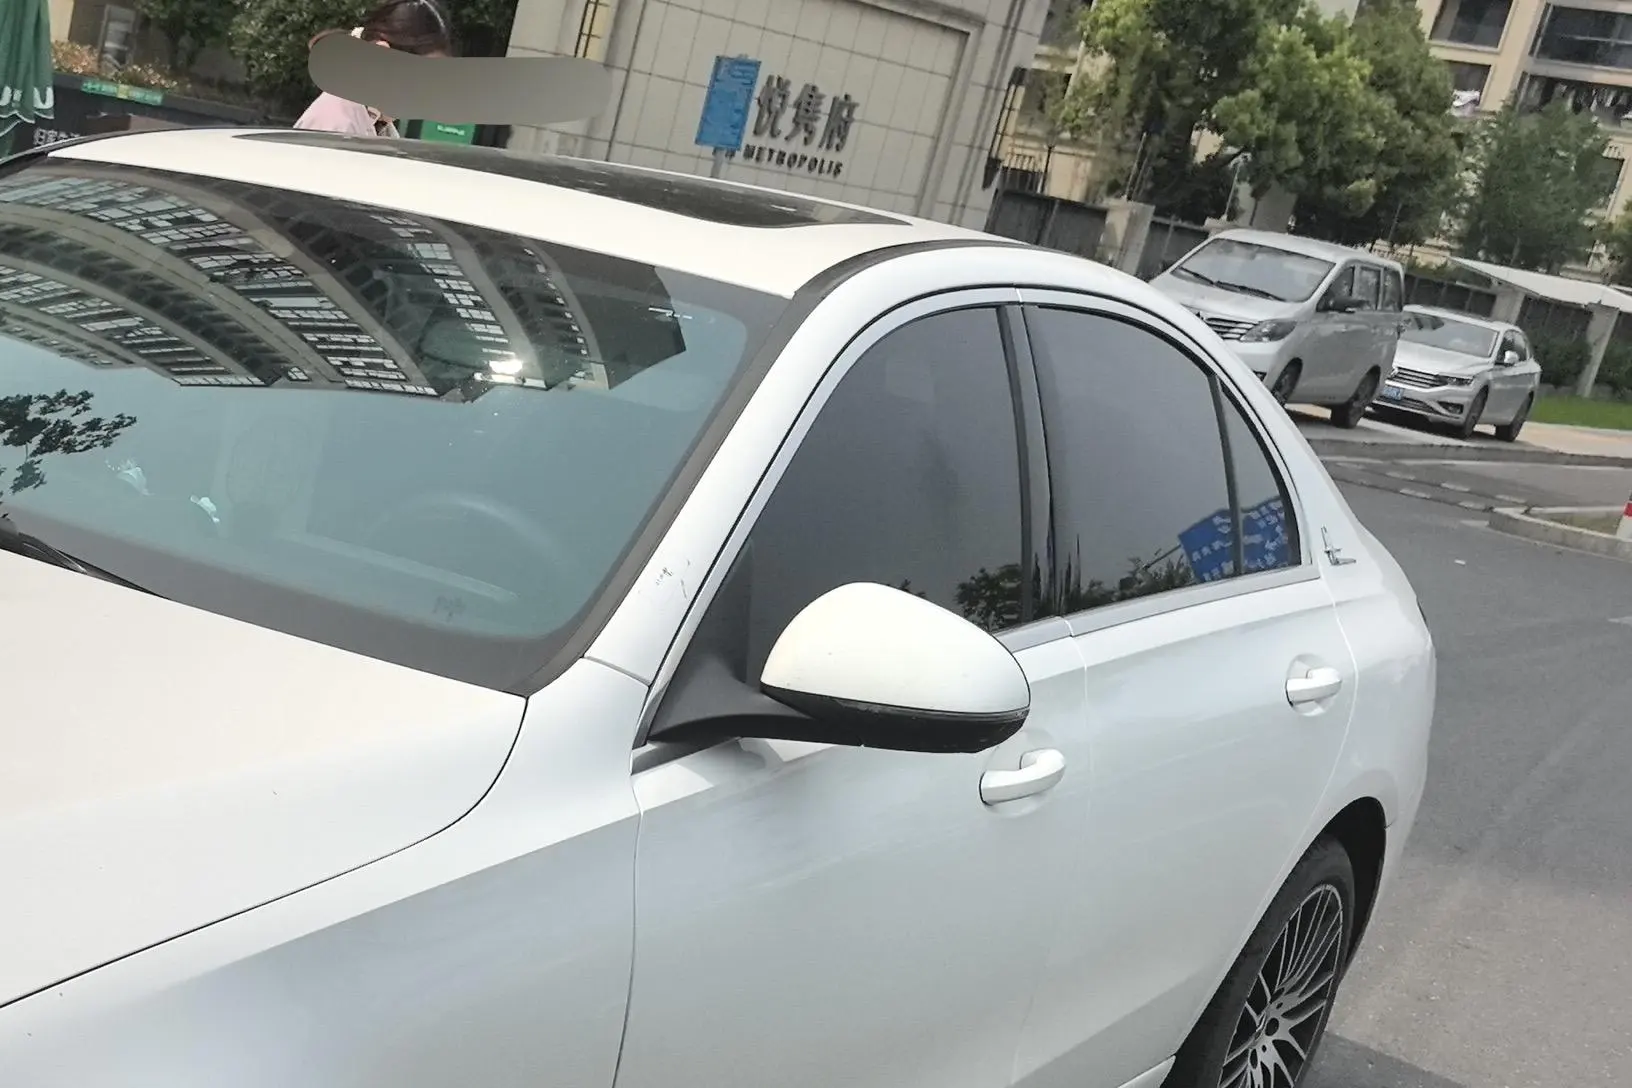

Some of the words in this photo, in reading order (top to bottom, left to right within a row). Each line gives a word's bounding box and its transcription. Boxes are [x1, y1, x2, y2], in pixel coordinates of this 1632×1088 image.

[753, 75, 860, 152] 悦隽府
[743, 144, 843, 178] METROPOLIS
